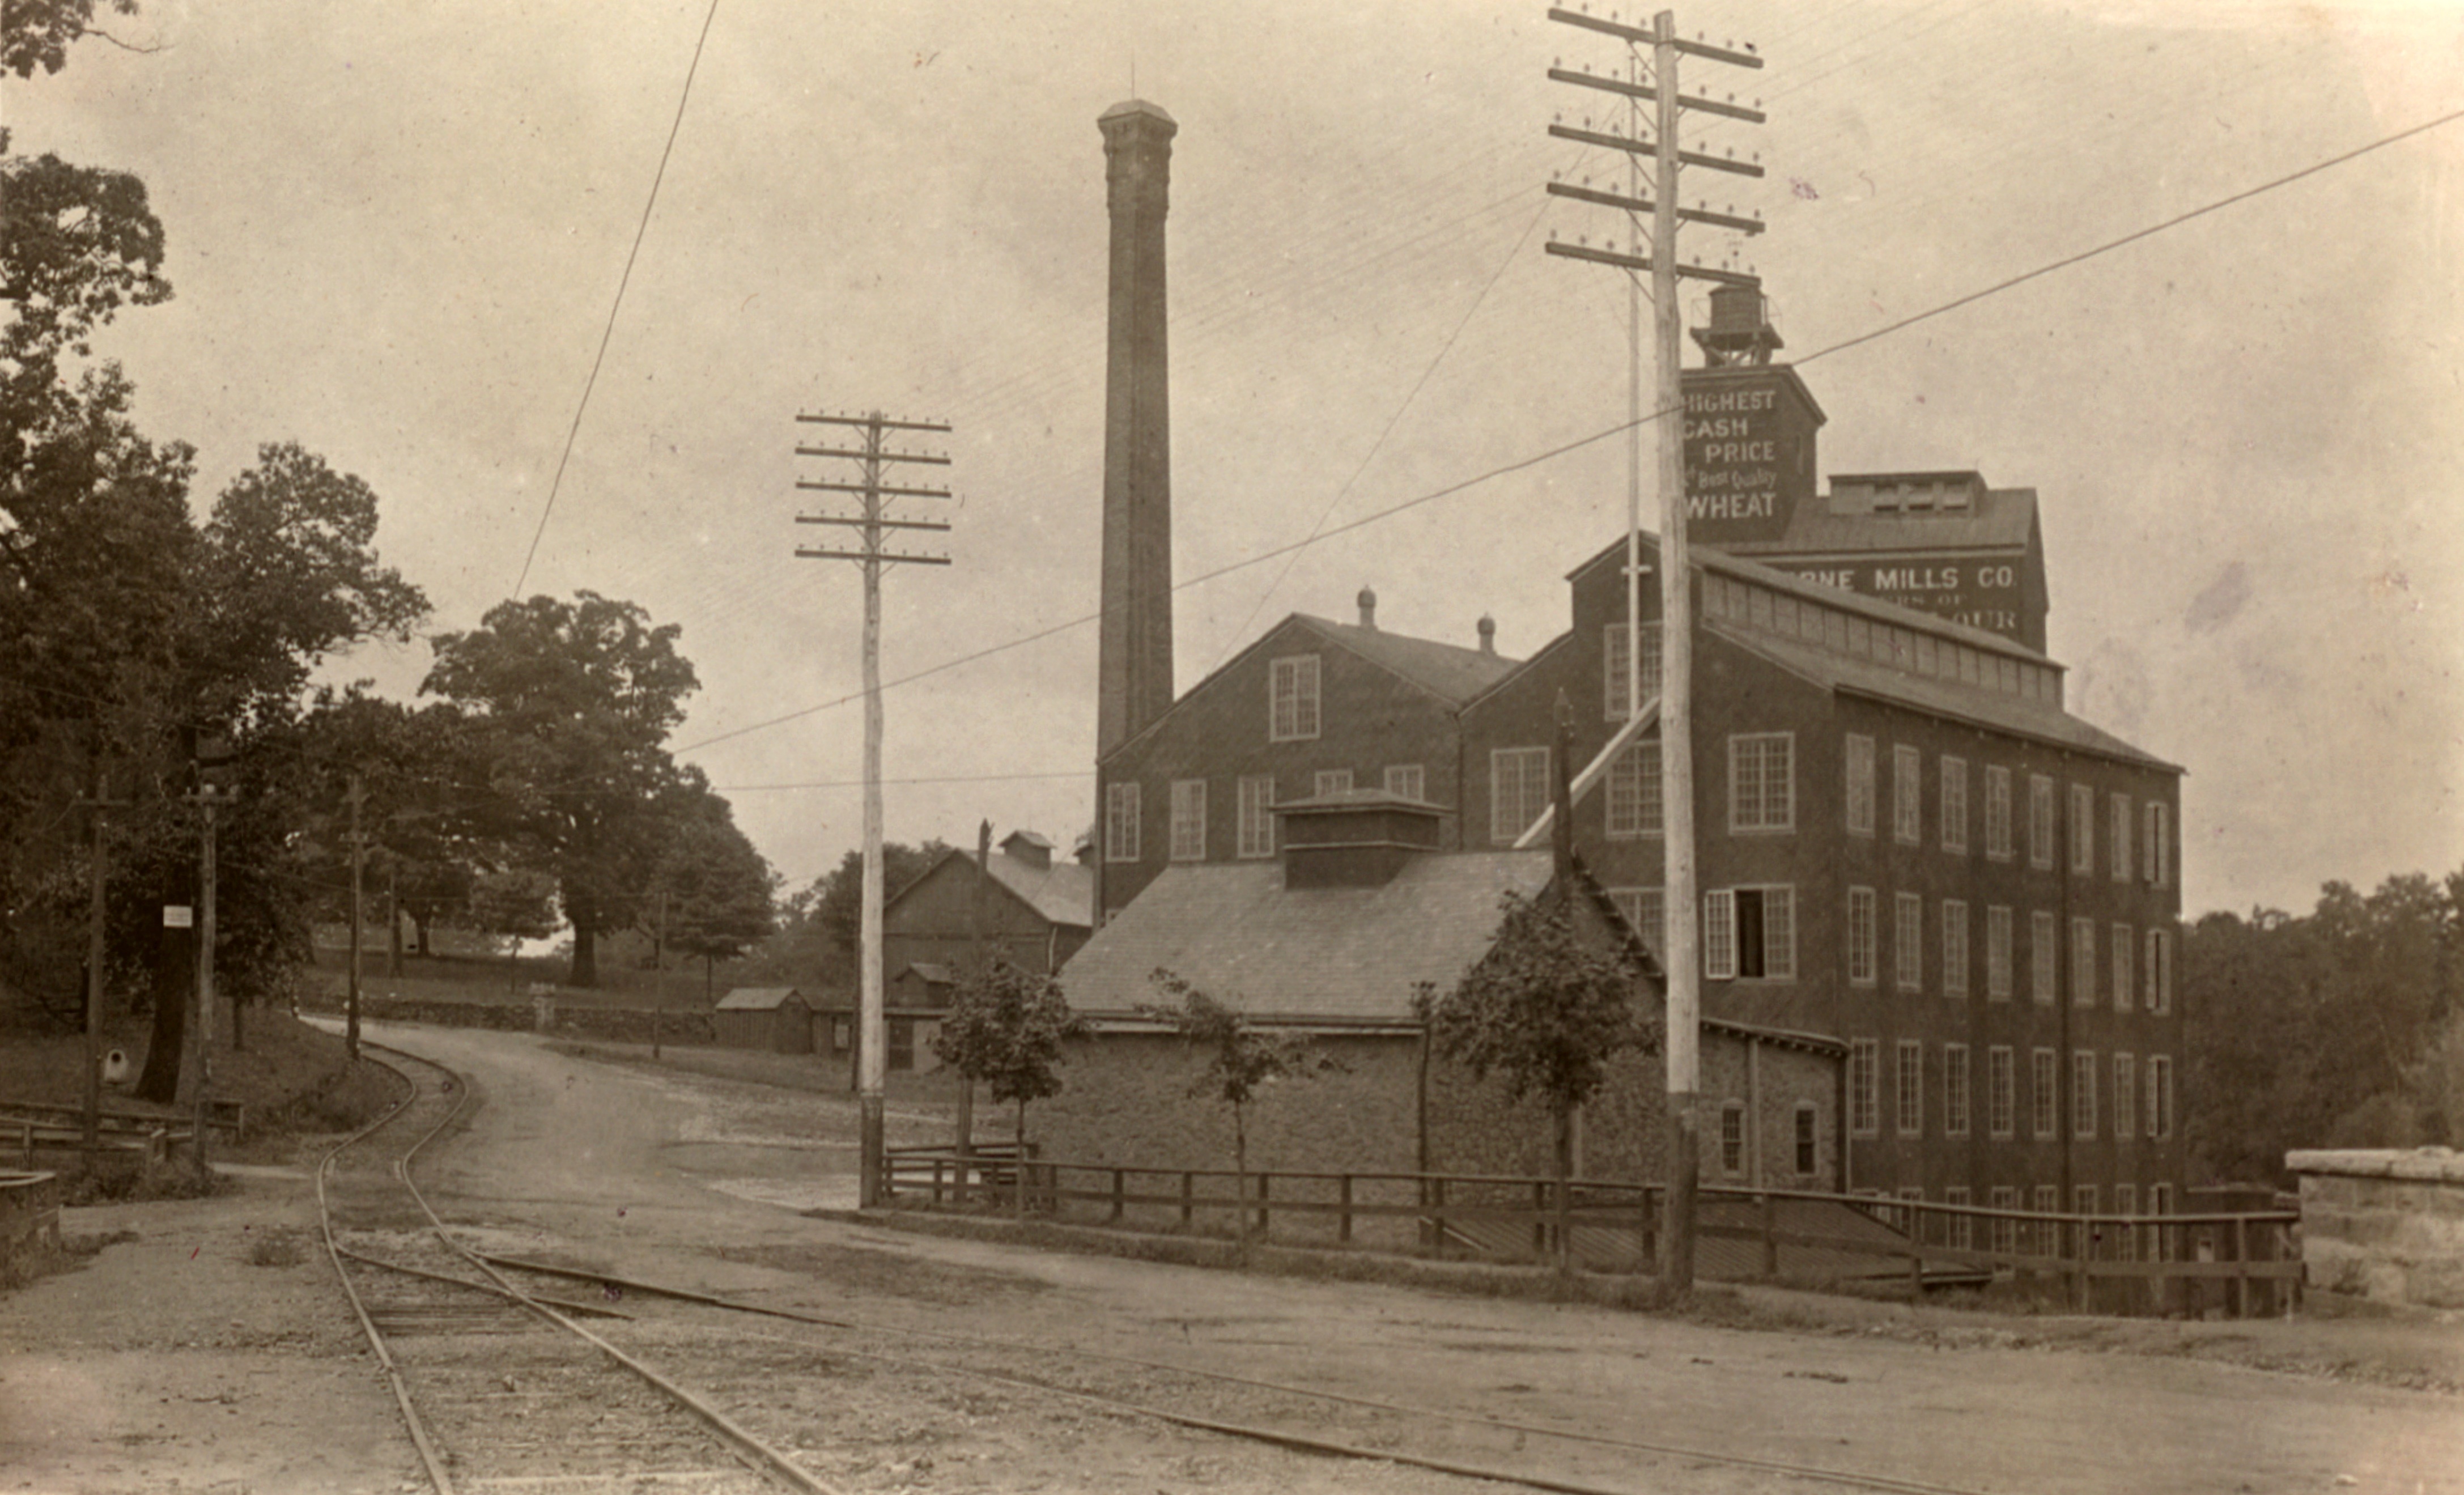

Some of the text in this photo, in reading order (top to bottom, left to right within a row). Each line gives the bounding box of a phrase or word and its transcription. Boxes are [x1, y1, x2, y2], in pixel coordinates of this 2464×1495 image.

[1681, 389, 1776, 413] HIGHEST
[1684, 418, 1748, 440] CASH
[1705, 441, 1775, 464] PRICE
[1684, 492, 1777, 520] WHEAT
[1875, 567, 1959, 591] MILLS
